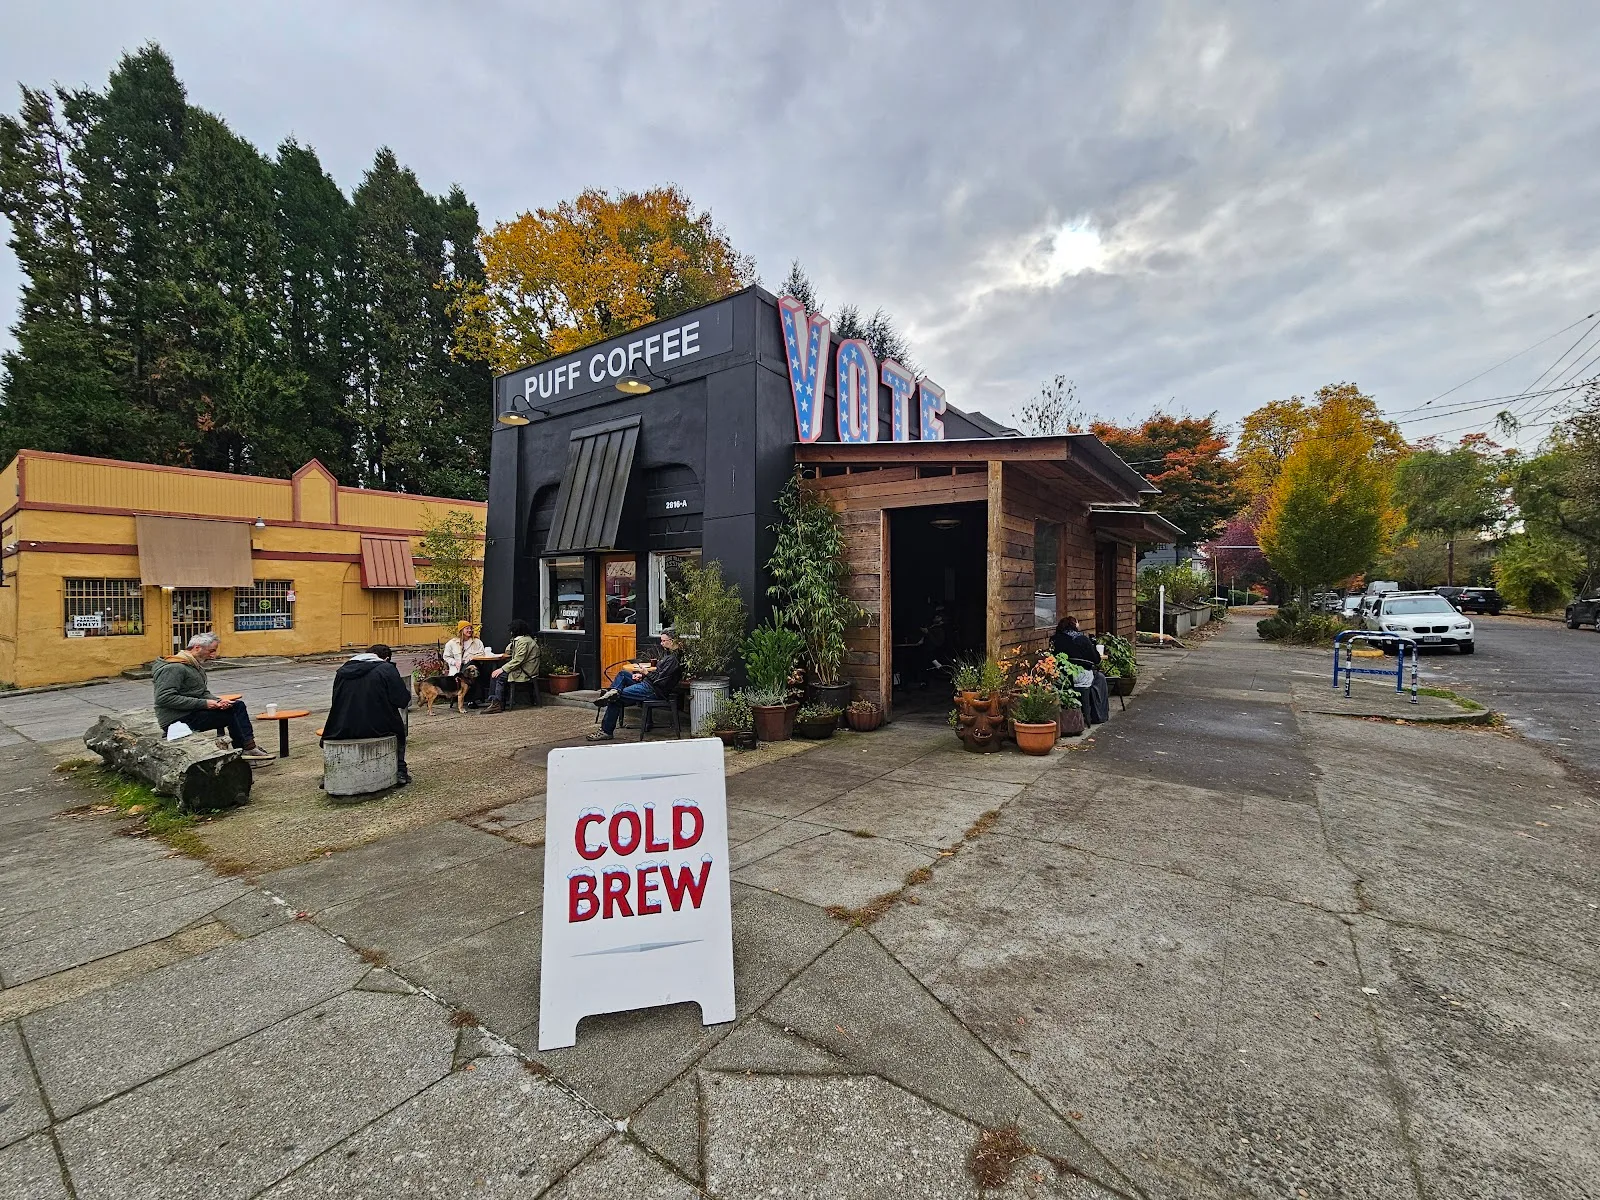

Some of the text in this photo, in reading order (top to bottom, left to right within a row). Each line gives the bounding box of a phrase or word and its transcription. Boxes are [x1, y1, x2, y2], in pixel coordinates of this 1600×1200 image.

[524, 320, 700, 402] PUFF COFFEE
[778, 295, 947, 443] VOTE
[574, 798, 705, 861] COLD
[566, 852, 713, 923] BREW
